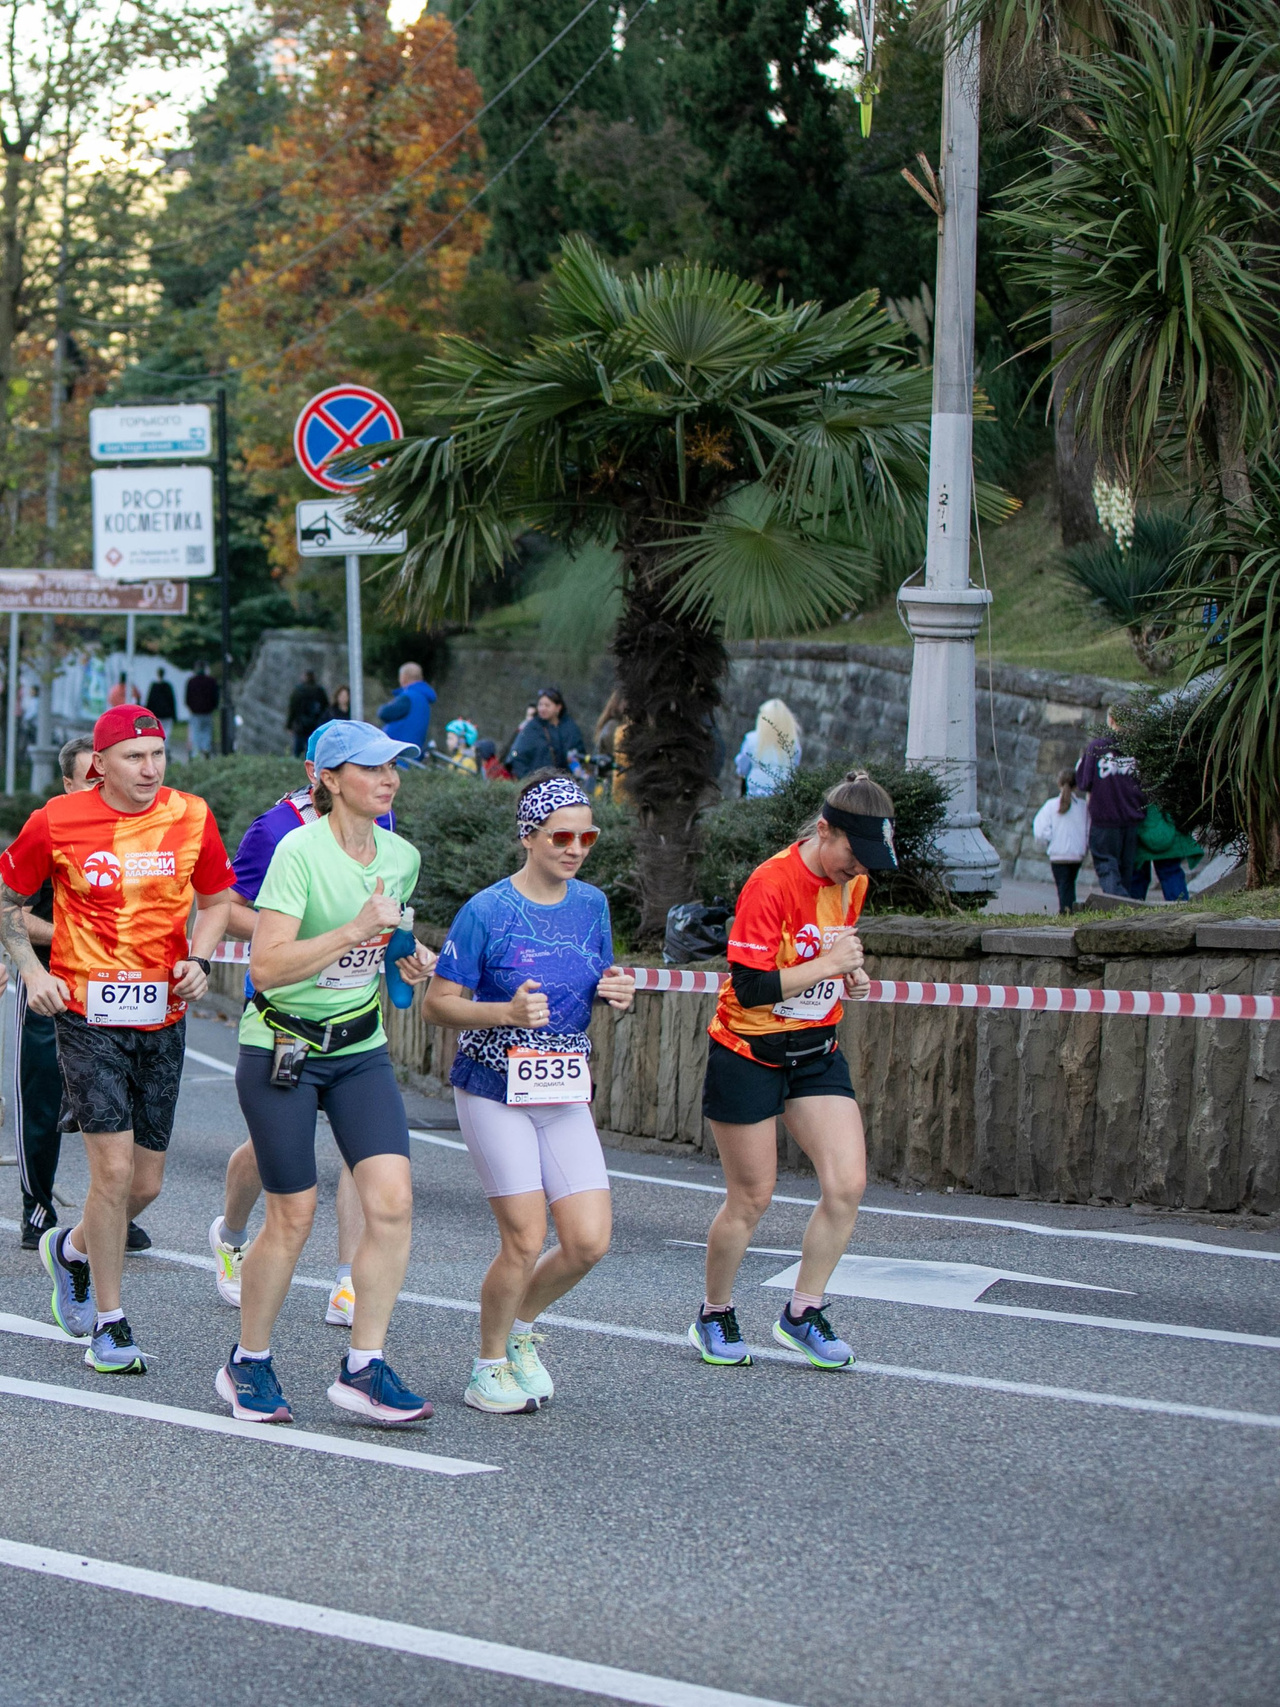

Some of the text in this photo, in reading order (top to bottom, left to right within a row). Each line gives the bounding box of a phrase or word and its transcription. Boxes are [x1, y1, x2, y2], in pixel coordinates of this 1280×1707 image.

[122, 488, 183, 509] PROFF
[104, 511, 202, 534] КОСМЕТИКА
[124, 850, 175, 859] СОВКОМБАНК
[124, 857, 176, 870] СОЧИ
[125, 869, 175, 877] МАРАФОН
[728, 940, 768, 952] СОВКОМБАНК
[338, 946, 387, 969] 6313
[101, 984, 157, 1004] 6718
[794, 981, 835, 999] 818
[518, 1059, 581, 1081] 6535
